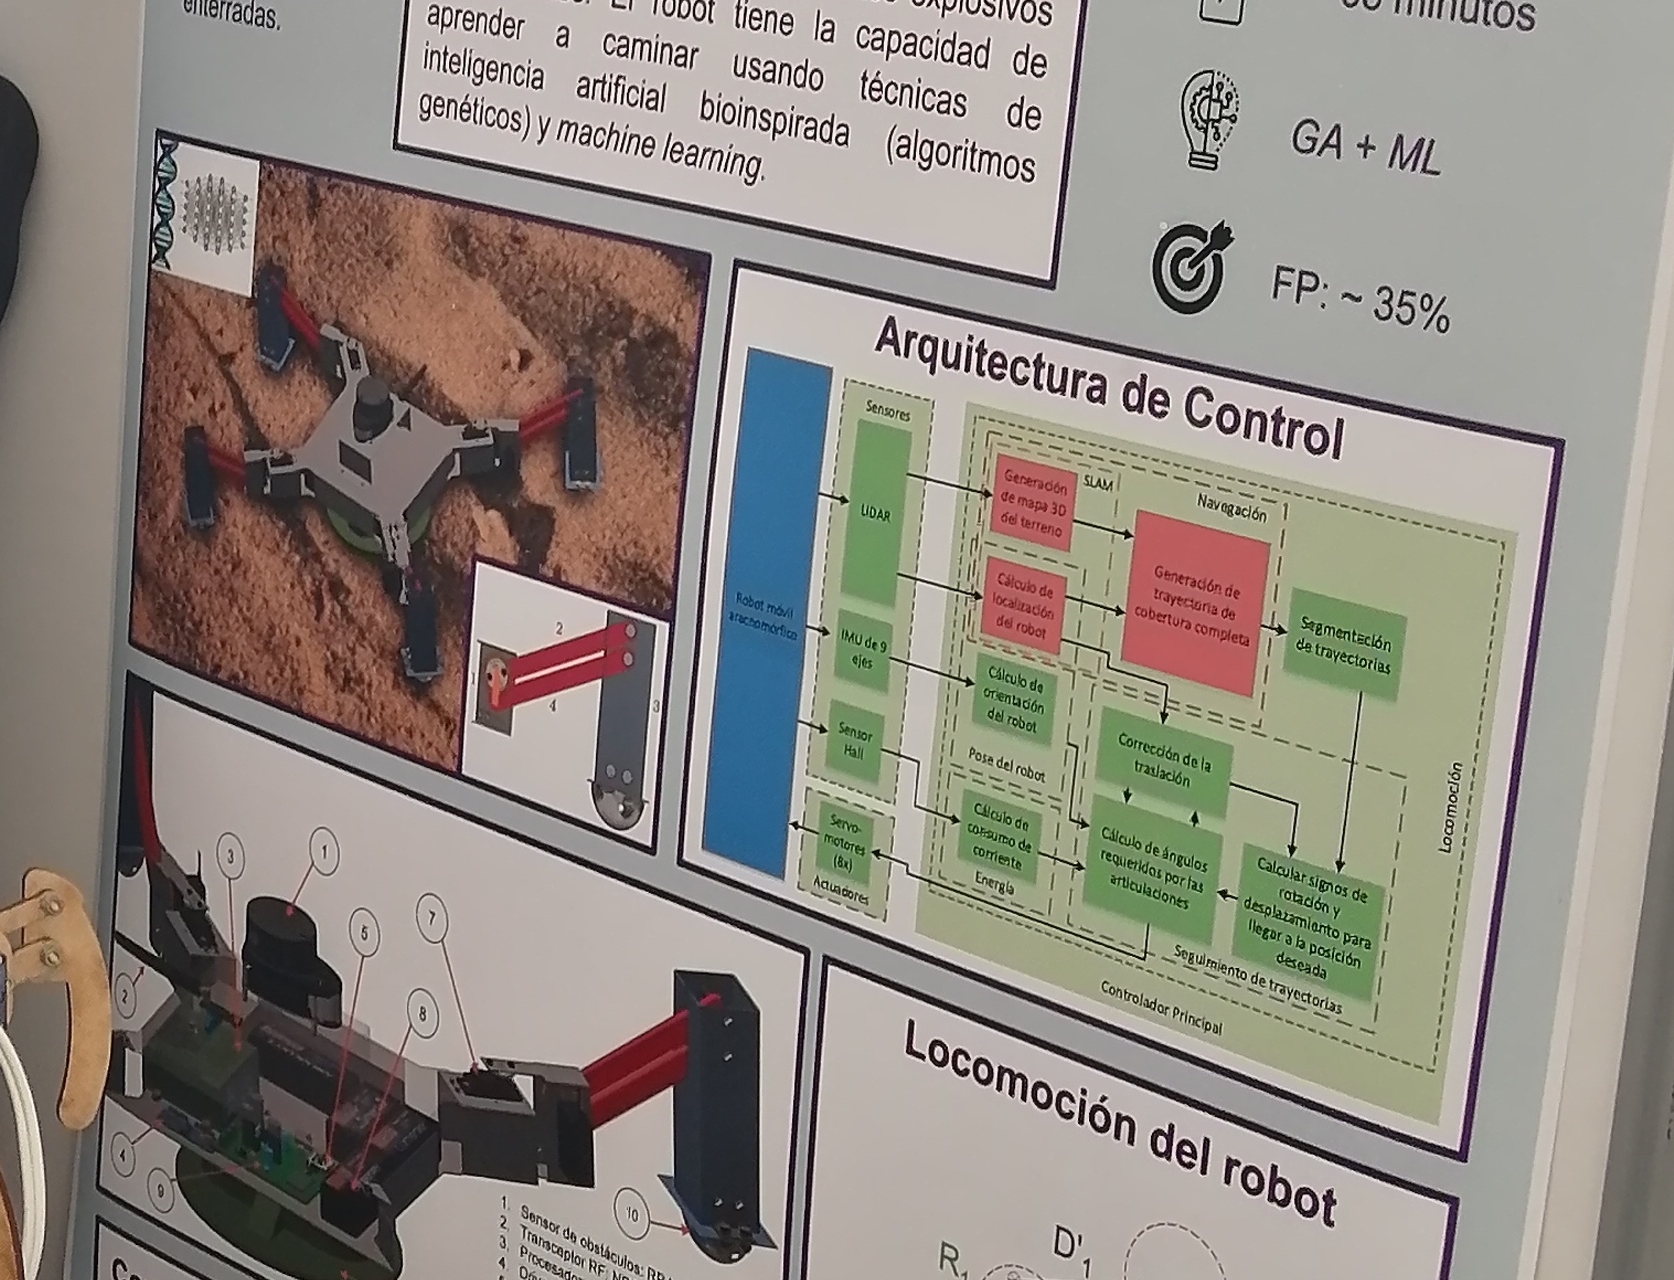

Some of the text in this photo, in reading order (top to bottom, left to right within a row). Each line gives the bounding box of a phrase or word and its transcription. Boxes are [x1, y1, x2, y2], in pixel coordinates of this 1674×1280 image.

[1293, 119, 1441, 176] GA + ML
[1273, 265, 1450, 334] FP: ~ 35%
[875, 315, 1344, 460] Arquitectura de Control
[866, 400, 911, 422] Sensores
[1083, 474, 1113, 492] SLAM
[861, 504, 891, 523] LIDAR
[1315, 641, 1391, 676] trayectorias
[839, 721, 872, 743] Sensor
[843, 743, 864, 761] Hall
[1118, 732, 1212, 773] Corrección de la
[1134, 759, 1191, 788] traslación
[1438, 762, 1463, 854] Locomoción
[227, 848, 235, 863] 3
[1101, 980, 1223, 1036] Controlador Principal
[906, 1018, 1337, 1228] Locomoción del robot
